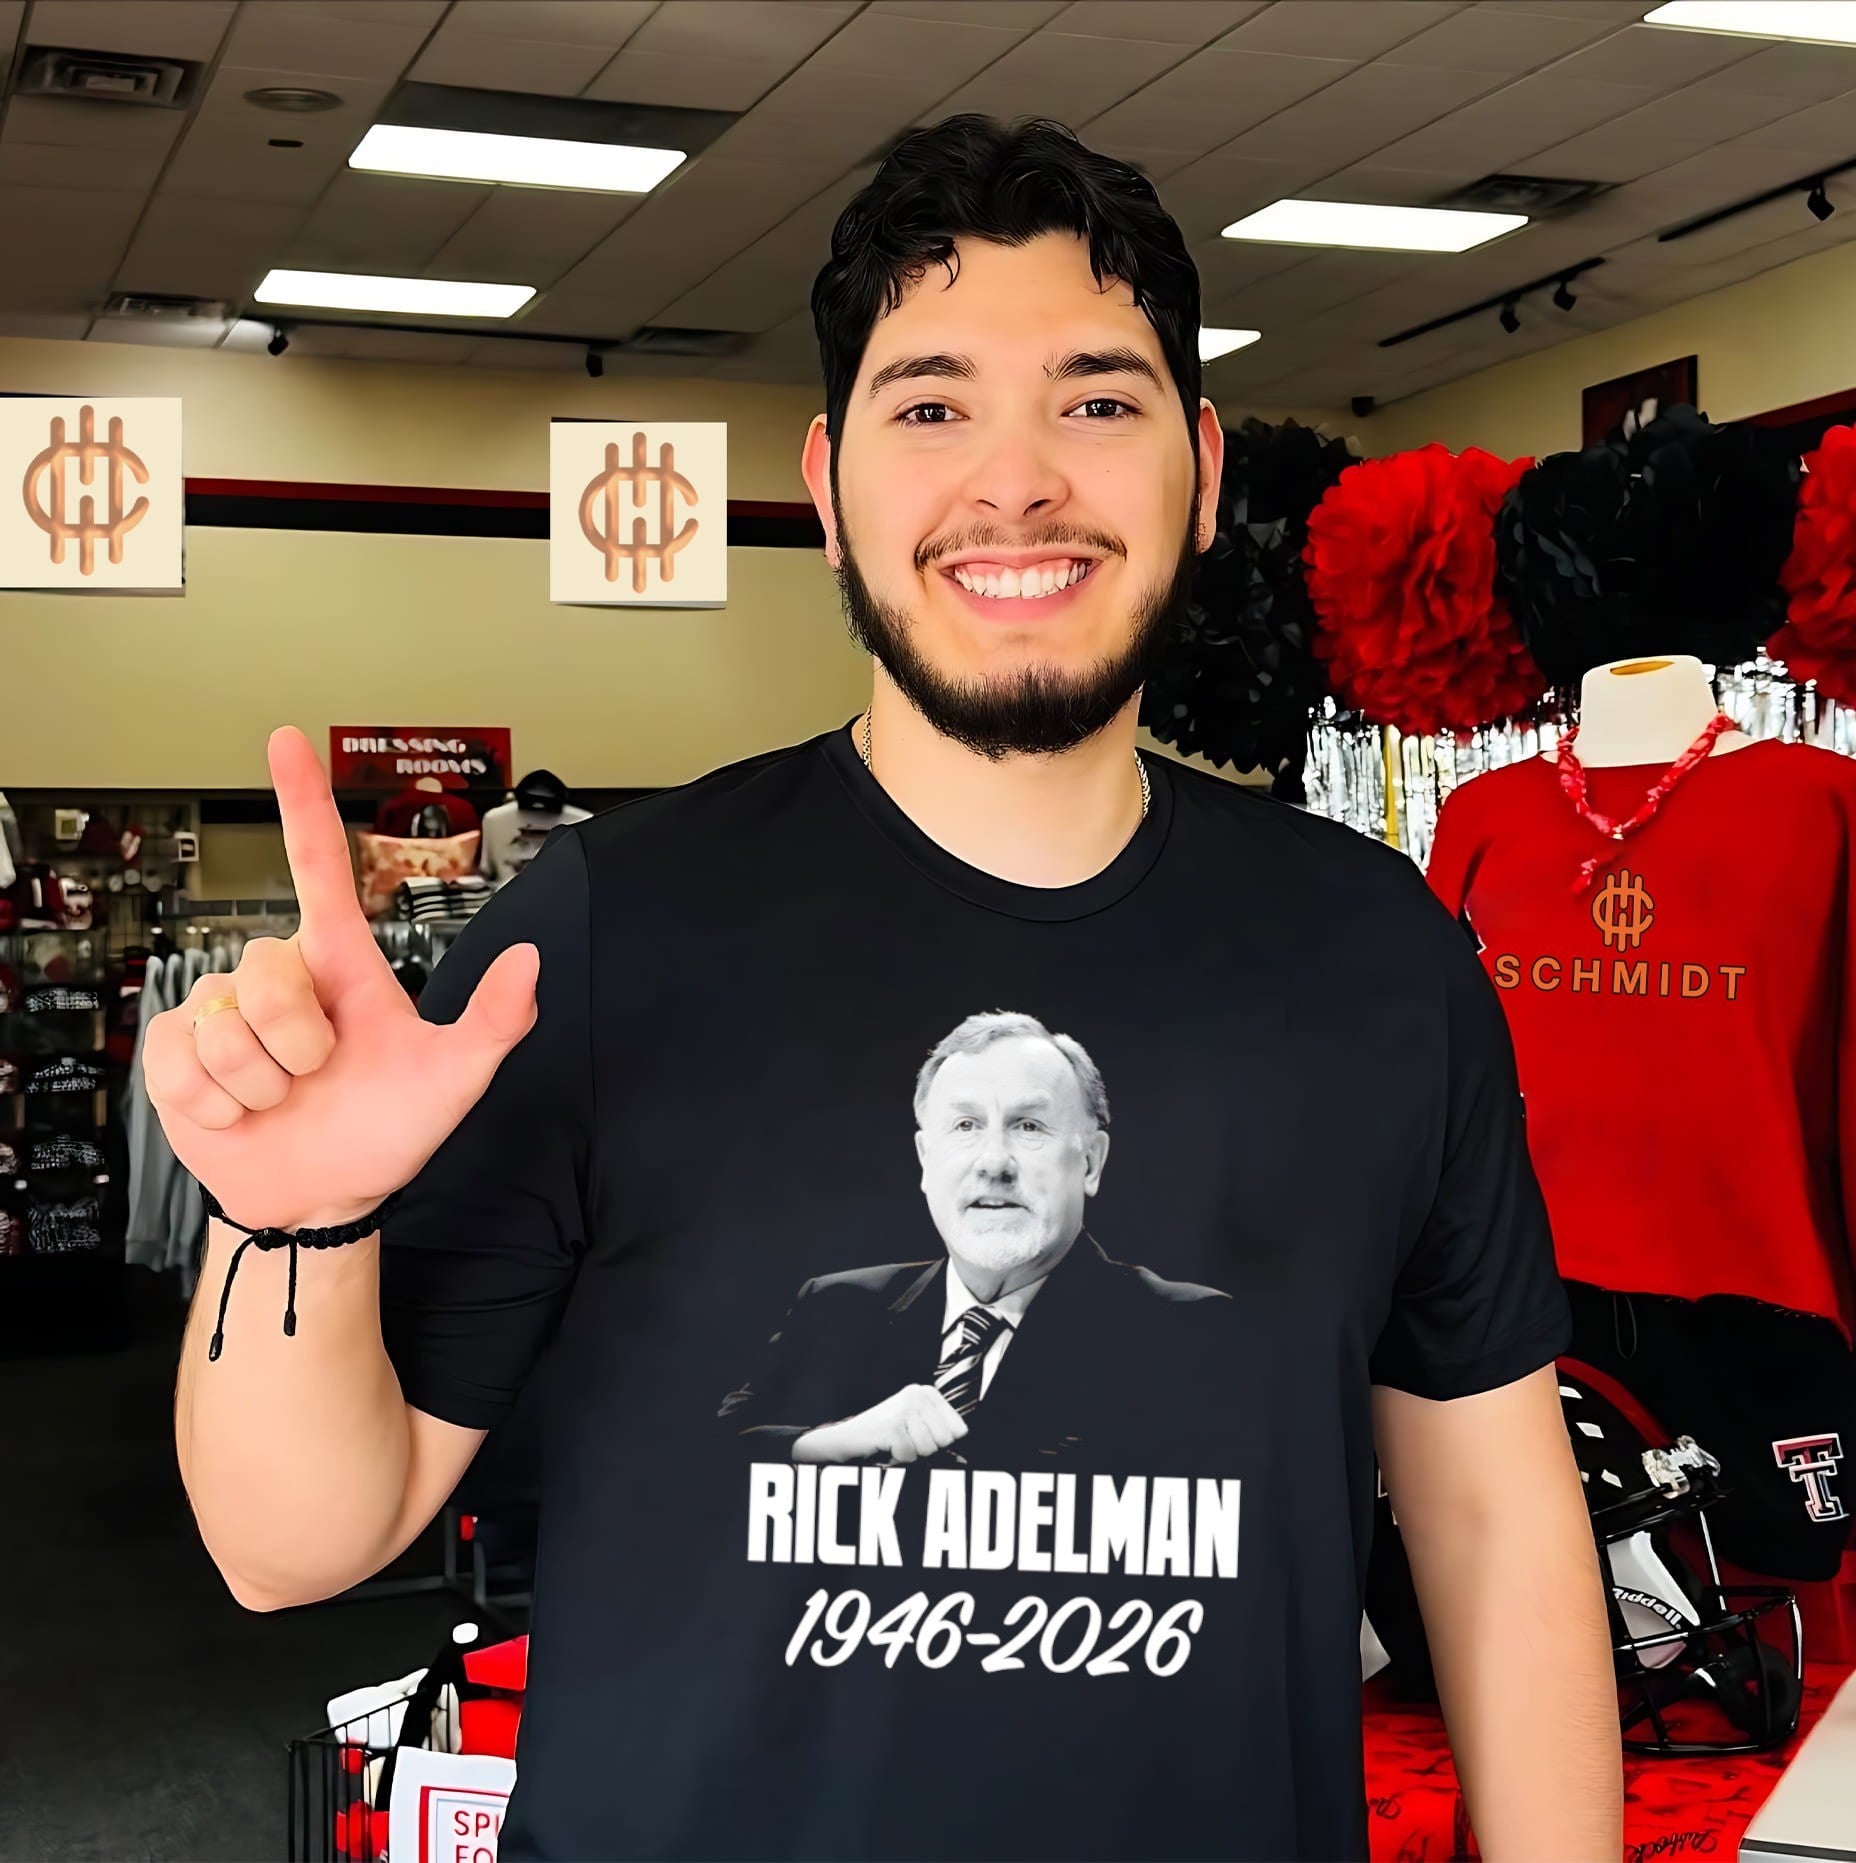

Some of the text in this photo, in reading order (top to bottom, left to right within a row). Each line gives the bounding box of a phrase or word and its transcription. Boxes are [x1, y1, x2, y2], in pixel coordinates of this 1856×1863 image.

[1494, 954, 1747, 1000] SCHMIDT
[747, 1462, 1241, 1578] RICK ADELMAN
[785, 1588, 1204, 1677] 1946-2026
